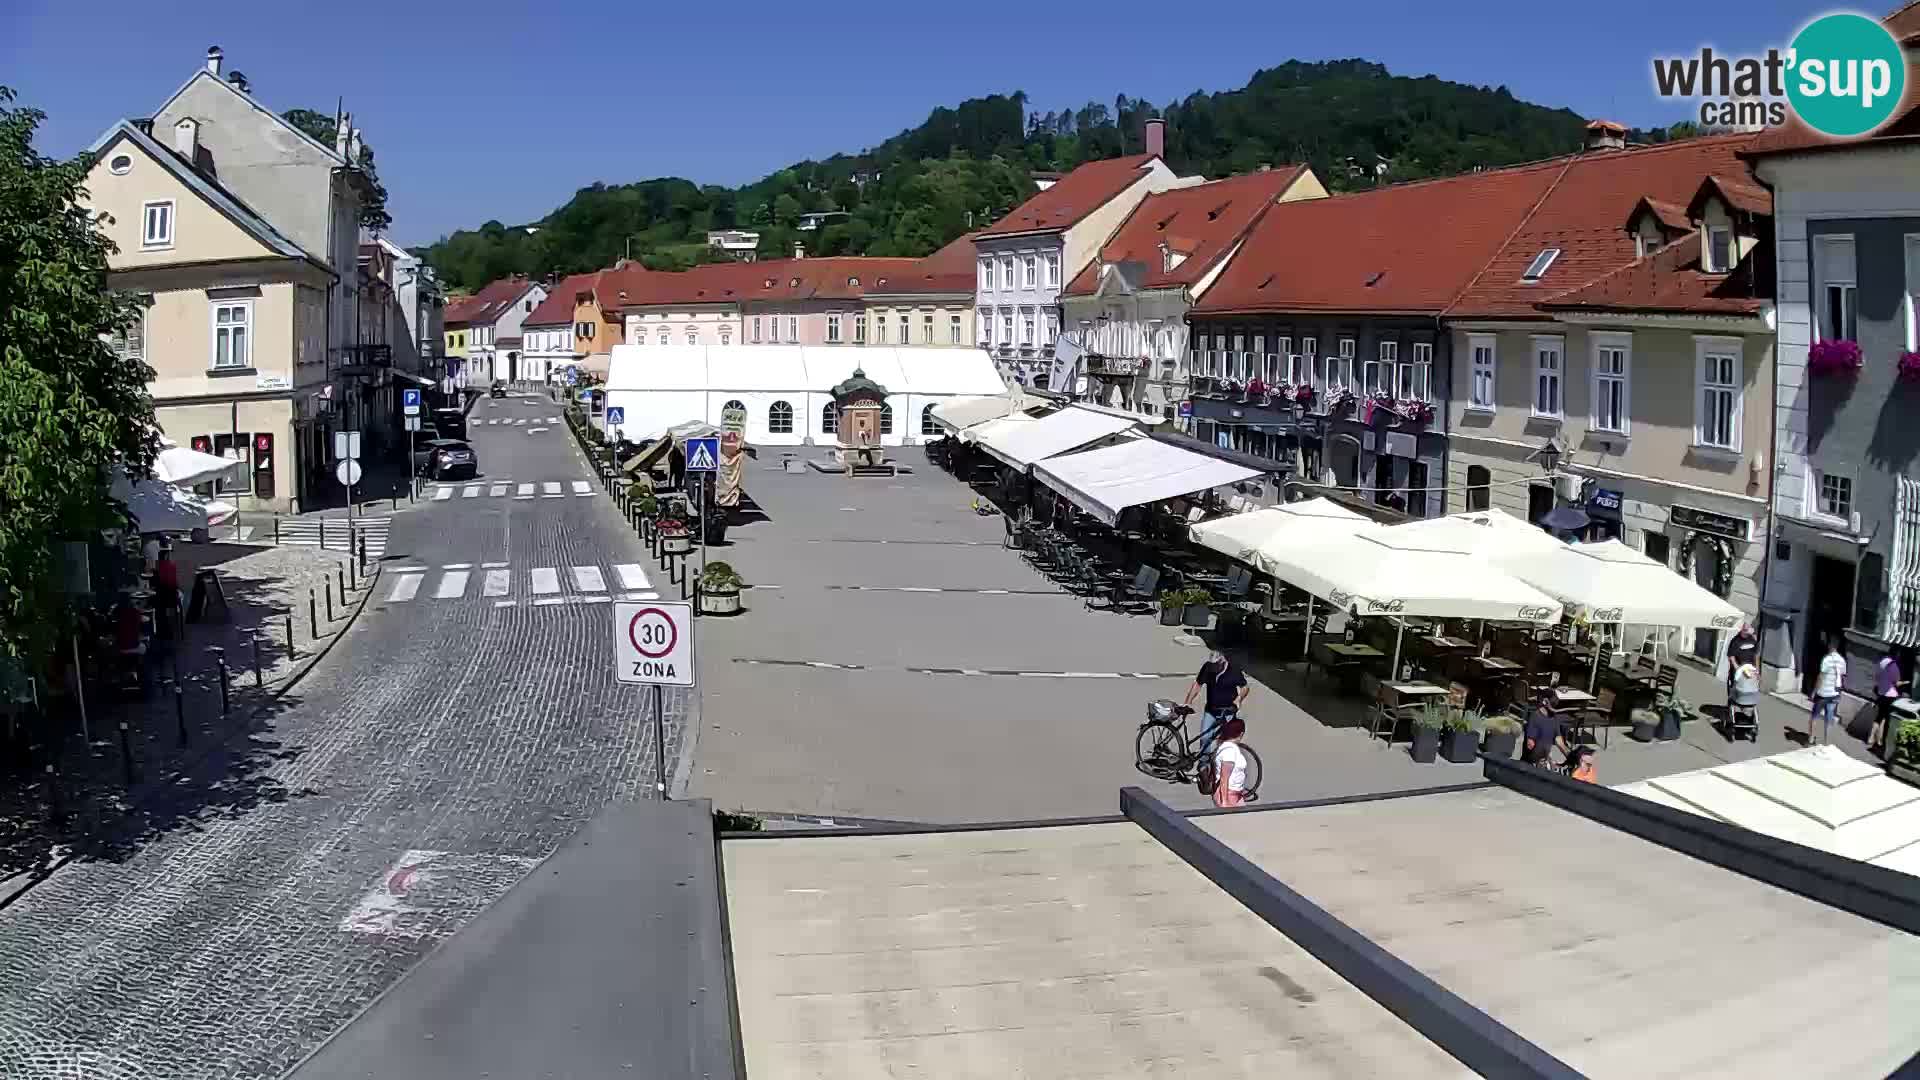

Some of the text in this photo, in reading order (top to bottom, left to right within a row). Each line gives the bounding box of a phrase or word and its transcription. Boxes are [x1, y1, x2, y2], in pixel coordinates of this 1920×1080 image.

[407, 393, 416, 403] P
[641, 624, 665, 645] 30
[632, 661, 676, 677] ZONA
